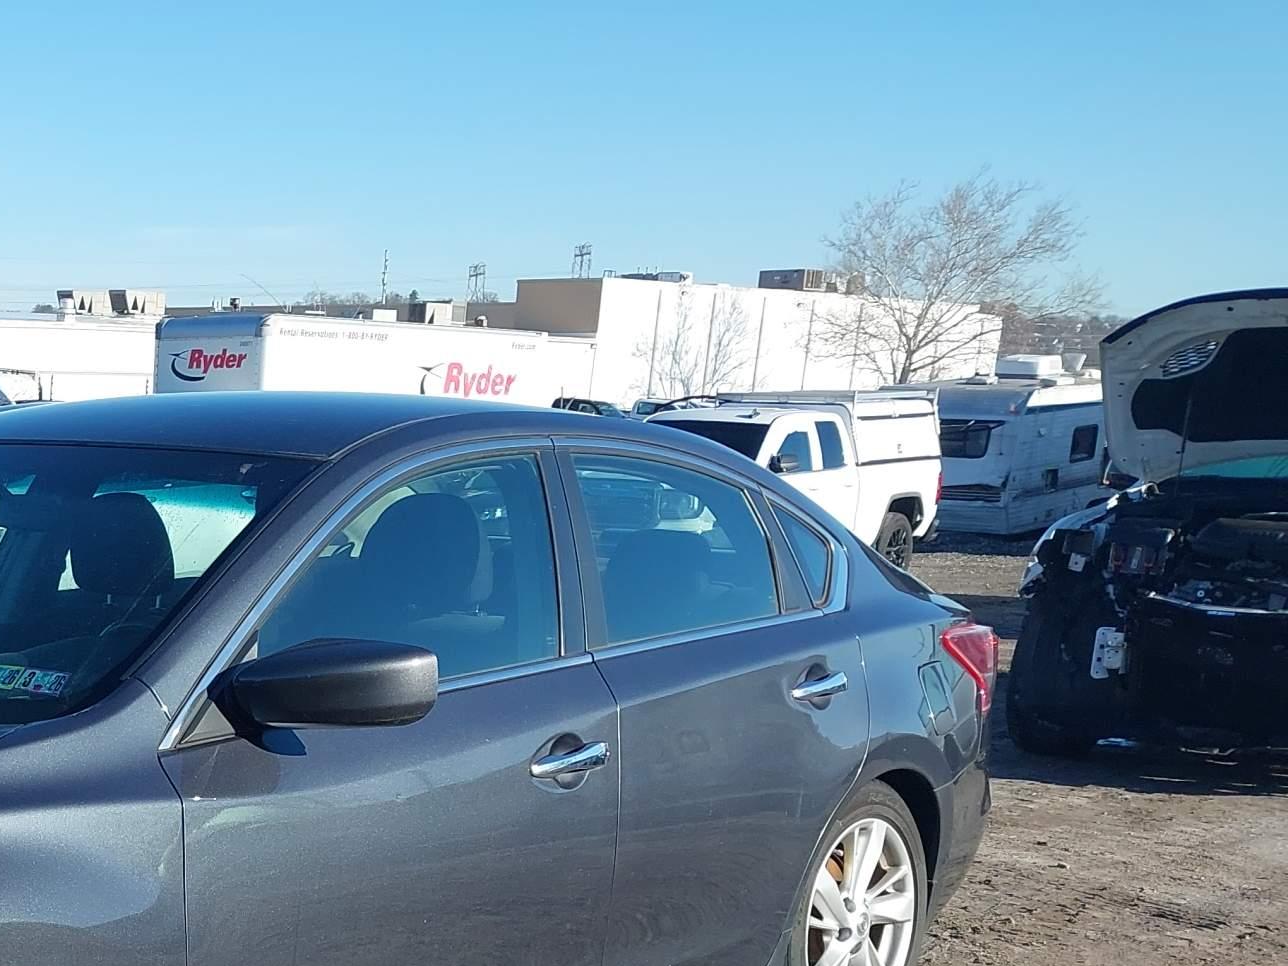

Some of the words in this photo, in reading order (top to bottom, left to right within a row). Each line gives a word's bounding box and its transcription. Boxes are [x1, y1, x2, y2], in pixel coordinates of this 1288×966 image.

[188, 348, 247, 375] Ryder
[443, 362, 517, 398] Ryder
[22, 671, 37, 688] 3
[48, 674, 66, 692] 26
